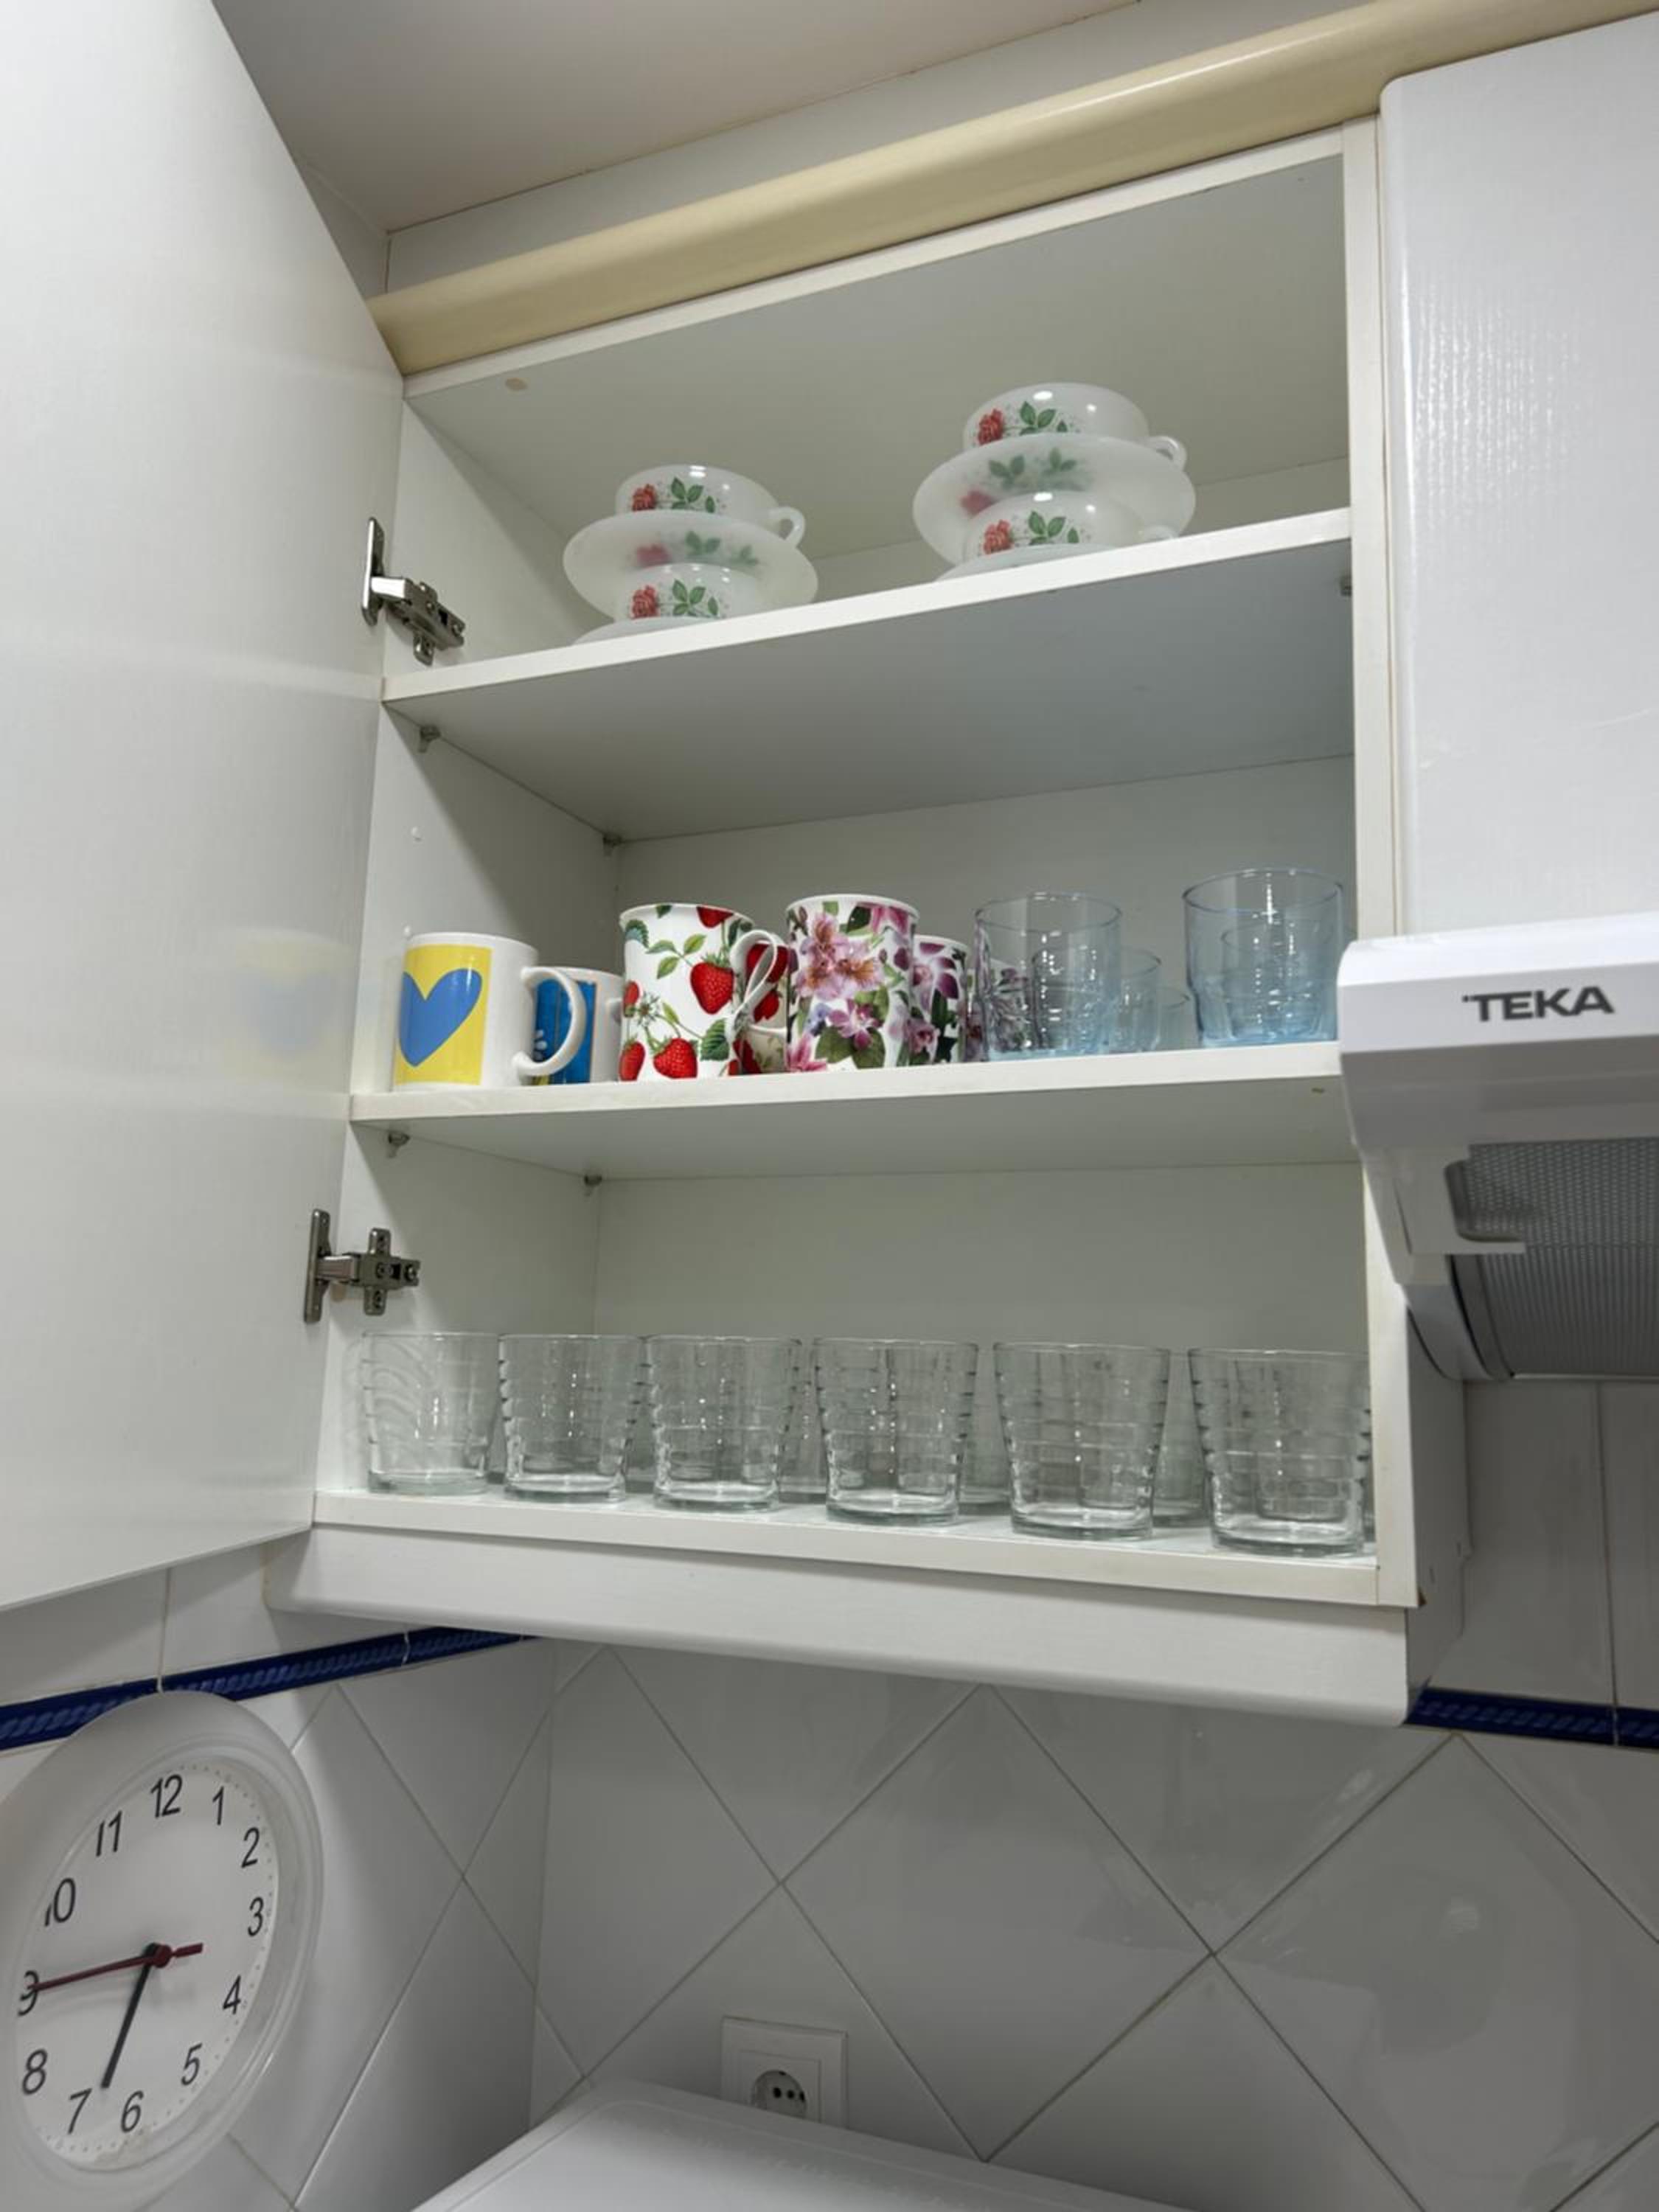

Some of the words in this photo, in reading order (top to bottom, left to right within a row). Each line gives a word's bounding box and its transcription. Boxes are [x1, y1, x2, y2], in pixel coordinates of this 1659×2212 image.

[1462, 987, 1615, 1022] TEKA
[150, 1774, 182, 1818] 12
[212, 1786, 224, 1825] 1
[96, 1810, 122, 1857] 11
[241, 1827, 260, 1868] 2
[247, 1896, 263, 1937] 3
[223, 1975, 241, 2014] 4
[22, 2049, 48, 2095] 8
[181, 2044, 202, 2085] 5
[68, 2089, 92, 2134] 7
[120, 2091, 144, 2132] 6
